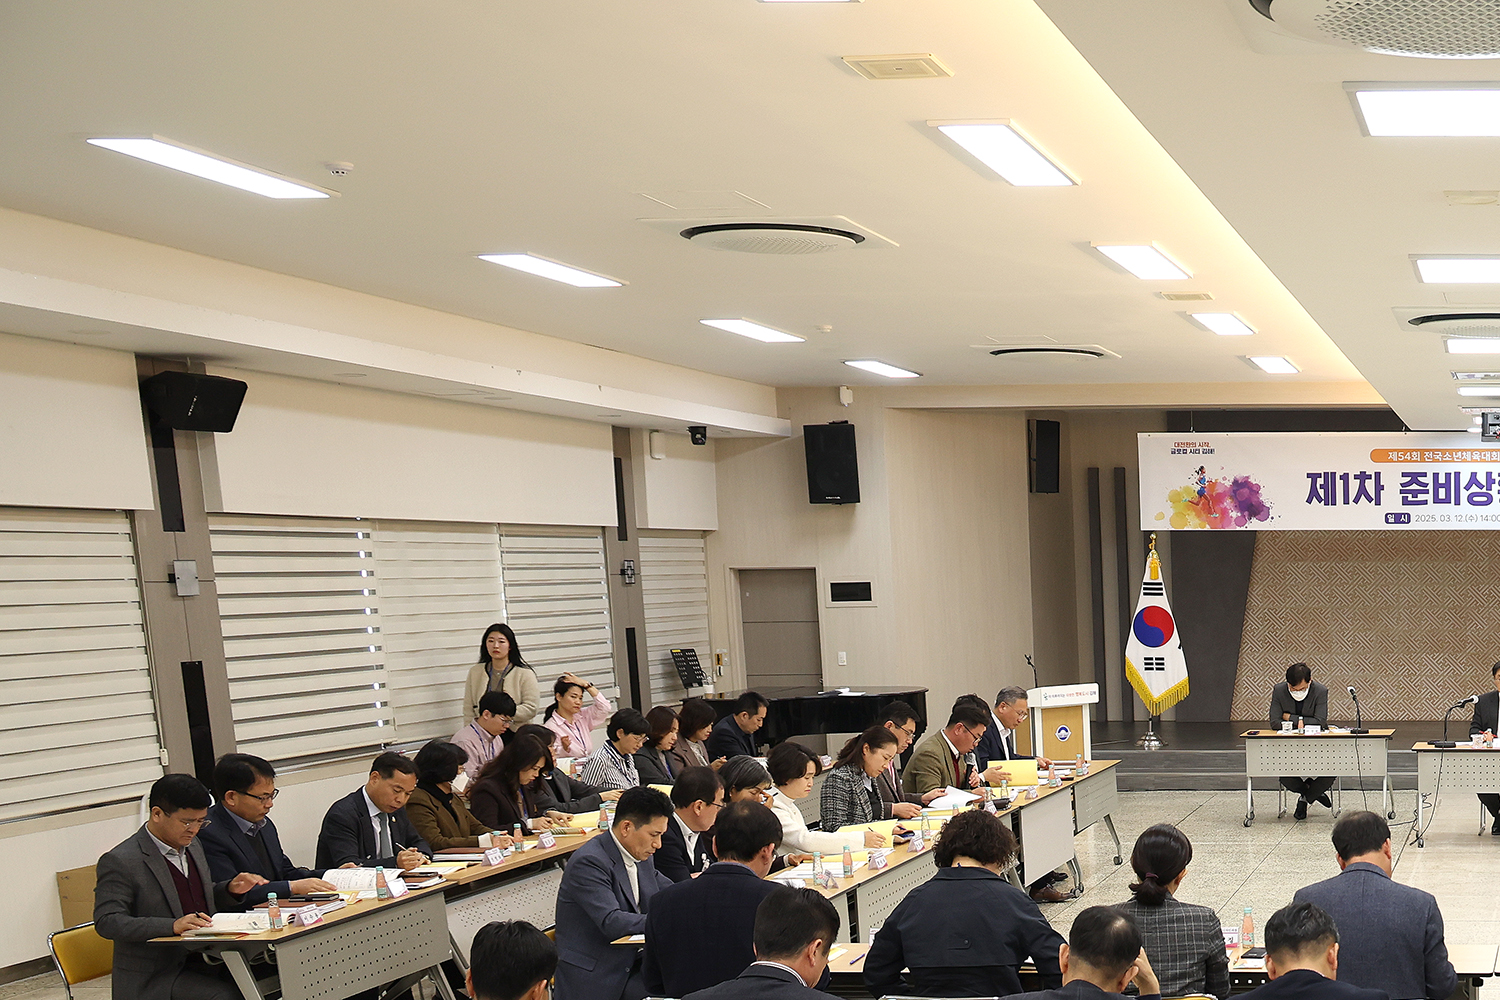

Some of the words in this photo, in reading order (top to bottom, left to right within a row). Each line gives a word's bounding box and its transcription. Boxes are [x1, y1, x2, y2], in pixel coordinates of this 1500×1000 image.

[1387, 451, 1420, 462] 제54회
[1305, 471, 1385, 506] 제1차
[1414, 514, 1439, 523] 2025.
[1439, 514, 1453, 523] 03.
